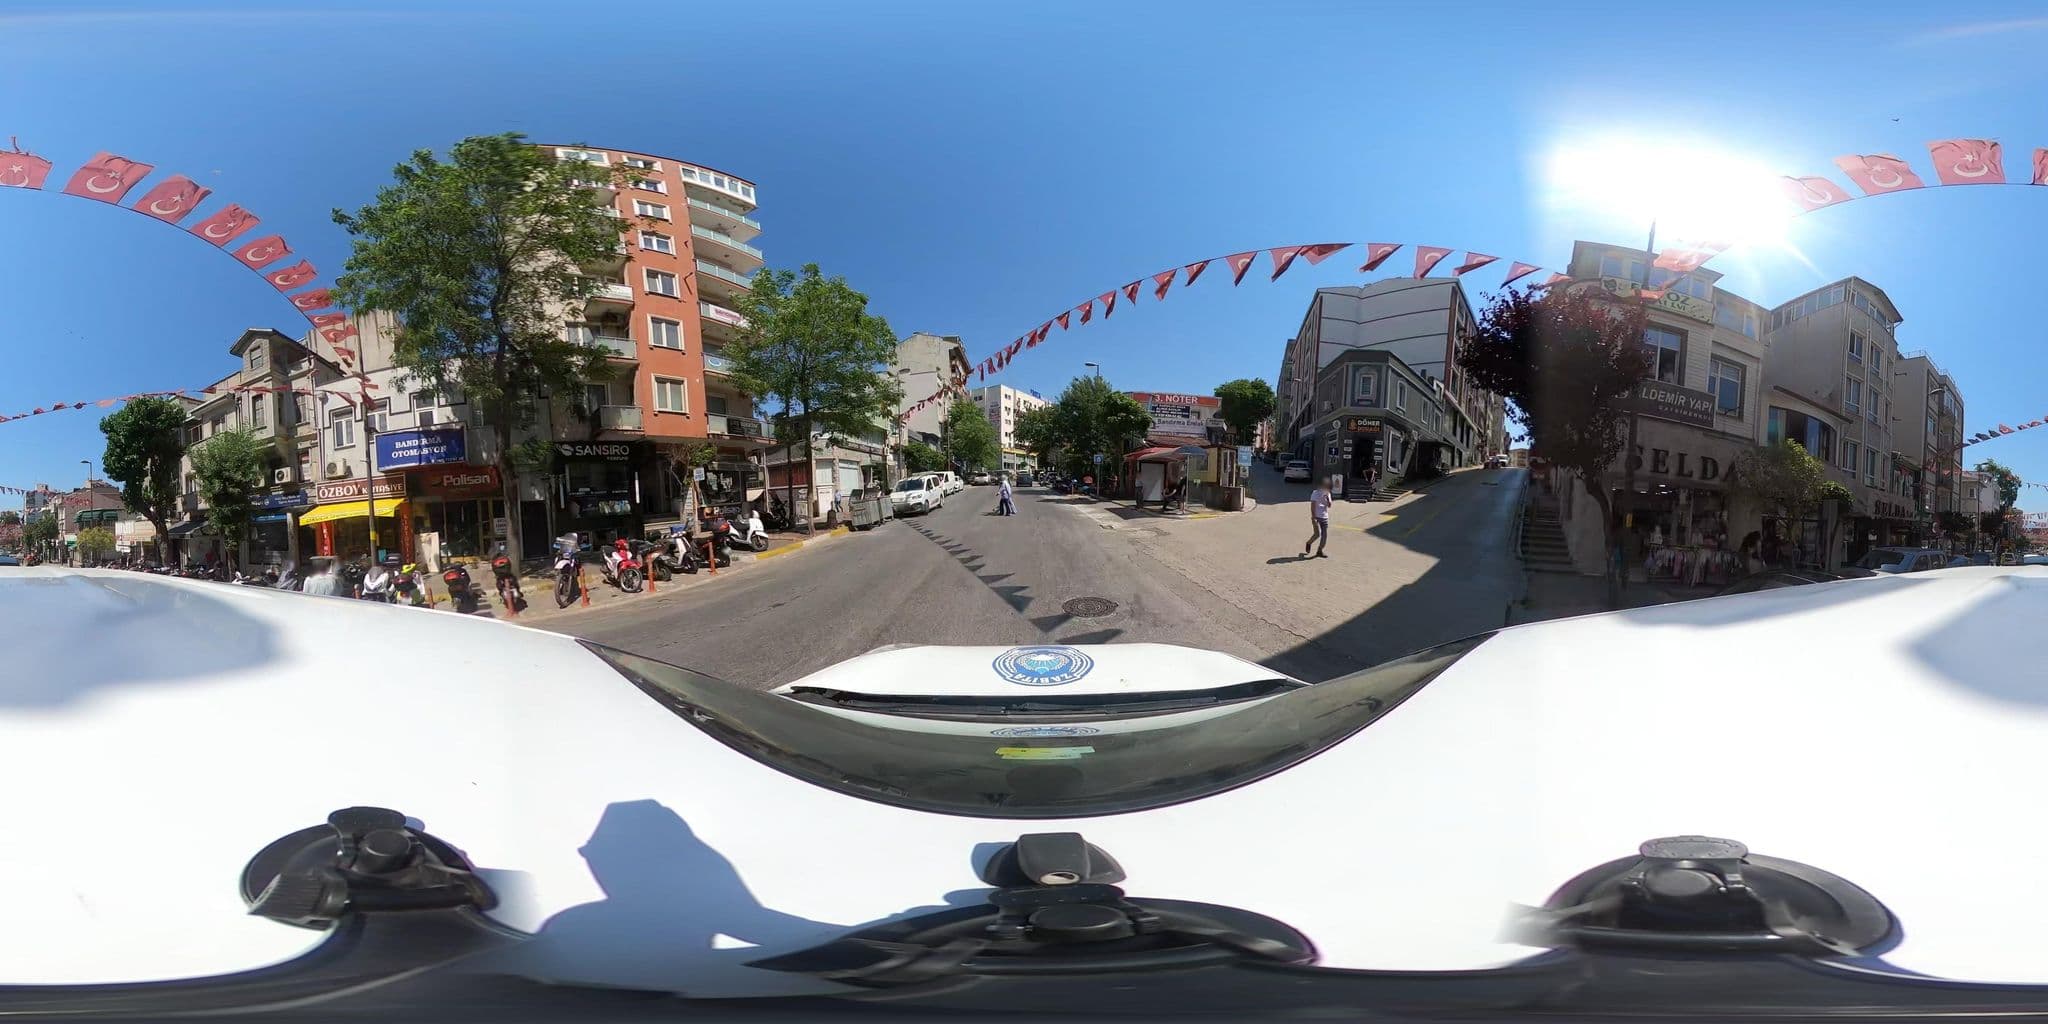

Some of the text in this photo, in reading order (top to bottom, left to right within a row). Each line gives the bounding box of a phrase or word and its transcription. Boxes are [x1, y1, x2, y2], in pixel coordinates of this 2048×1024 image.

[1165, 395, 1198, 404] NOTER
[1689, 397, 1713, 413] YAPI
[443, 474, 491, 487] Polisan
[319, 484, 361, 499] ÖZBOY
